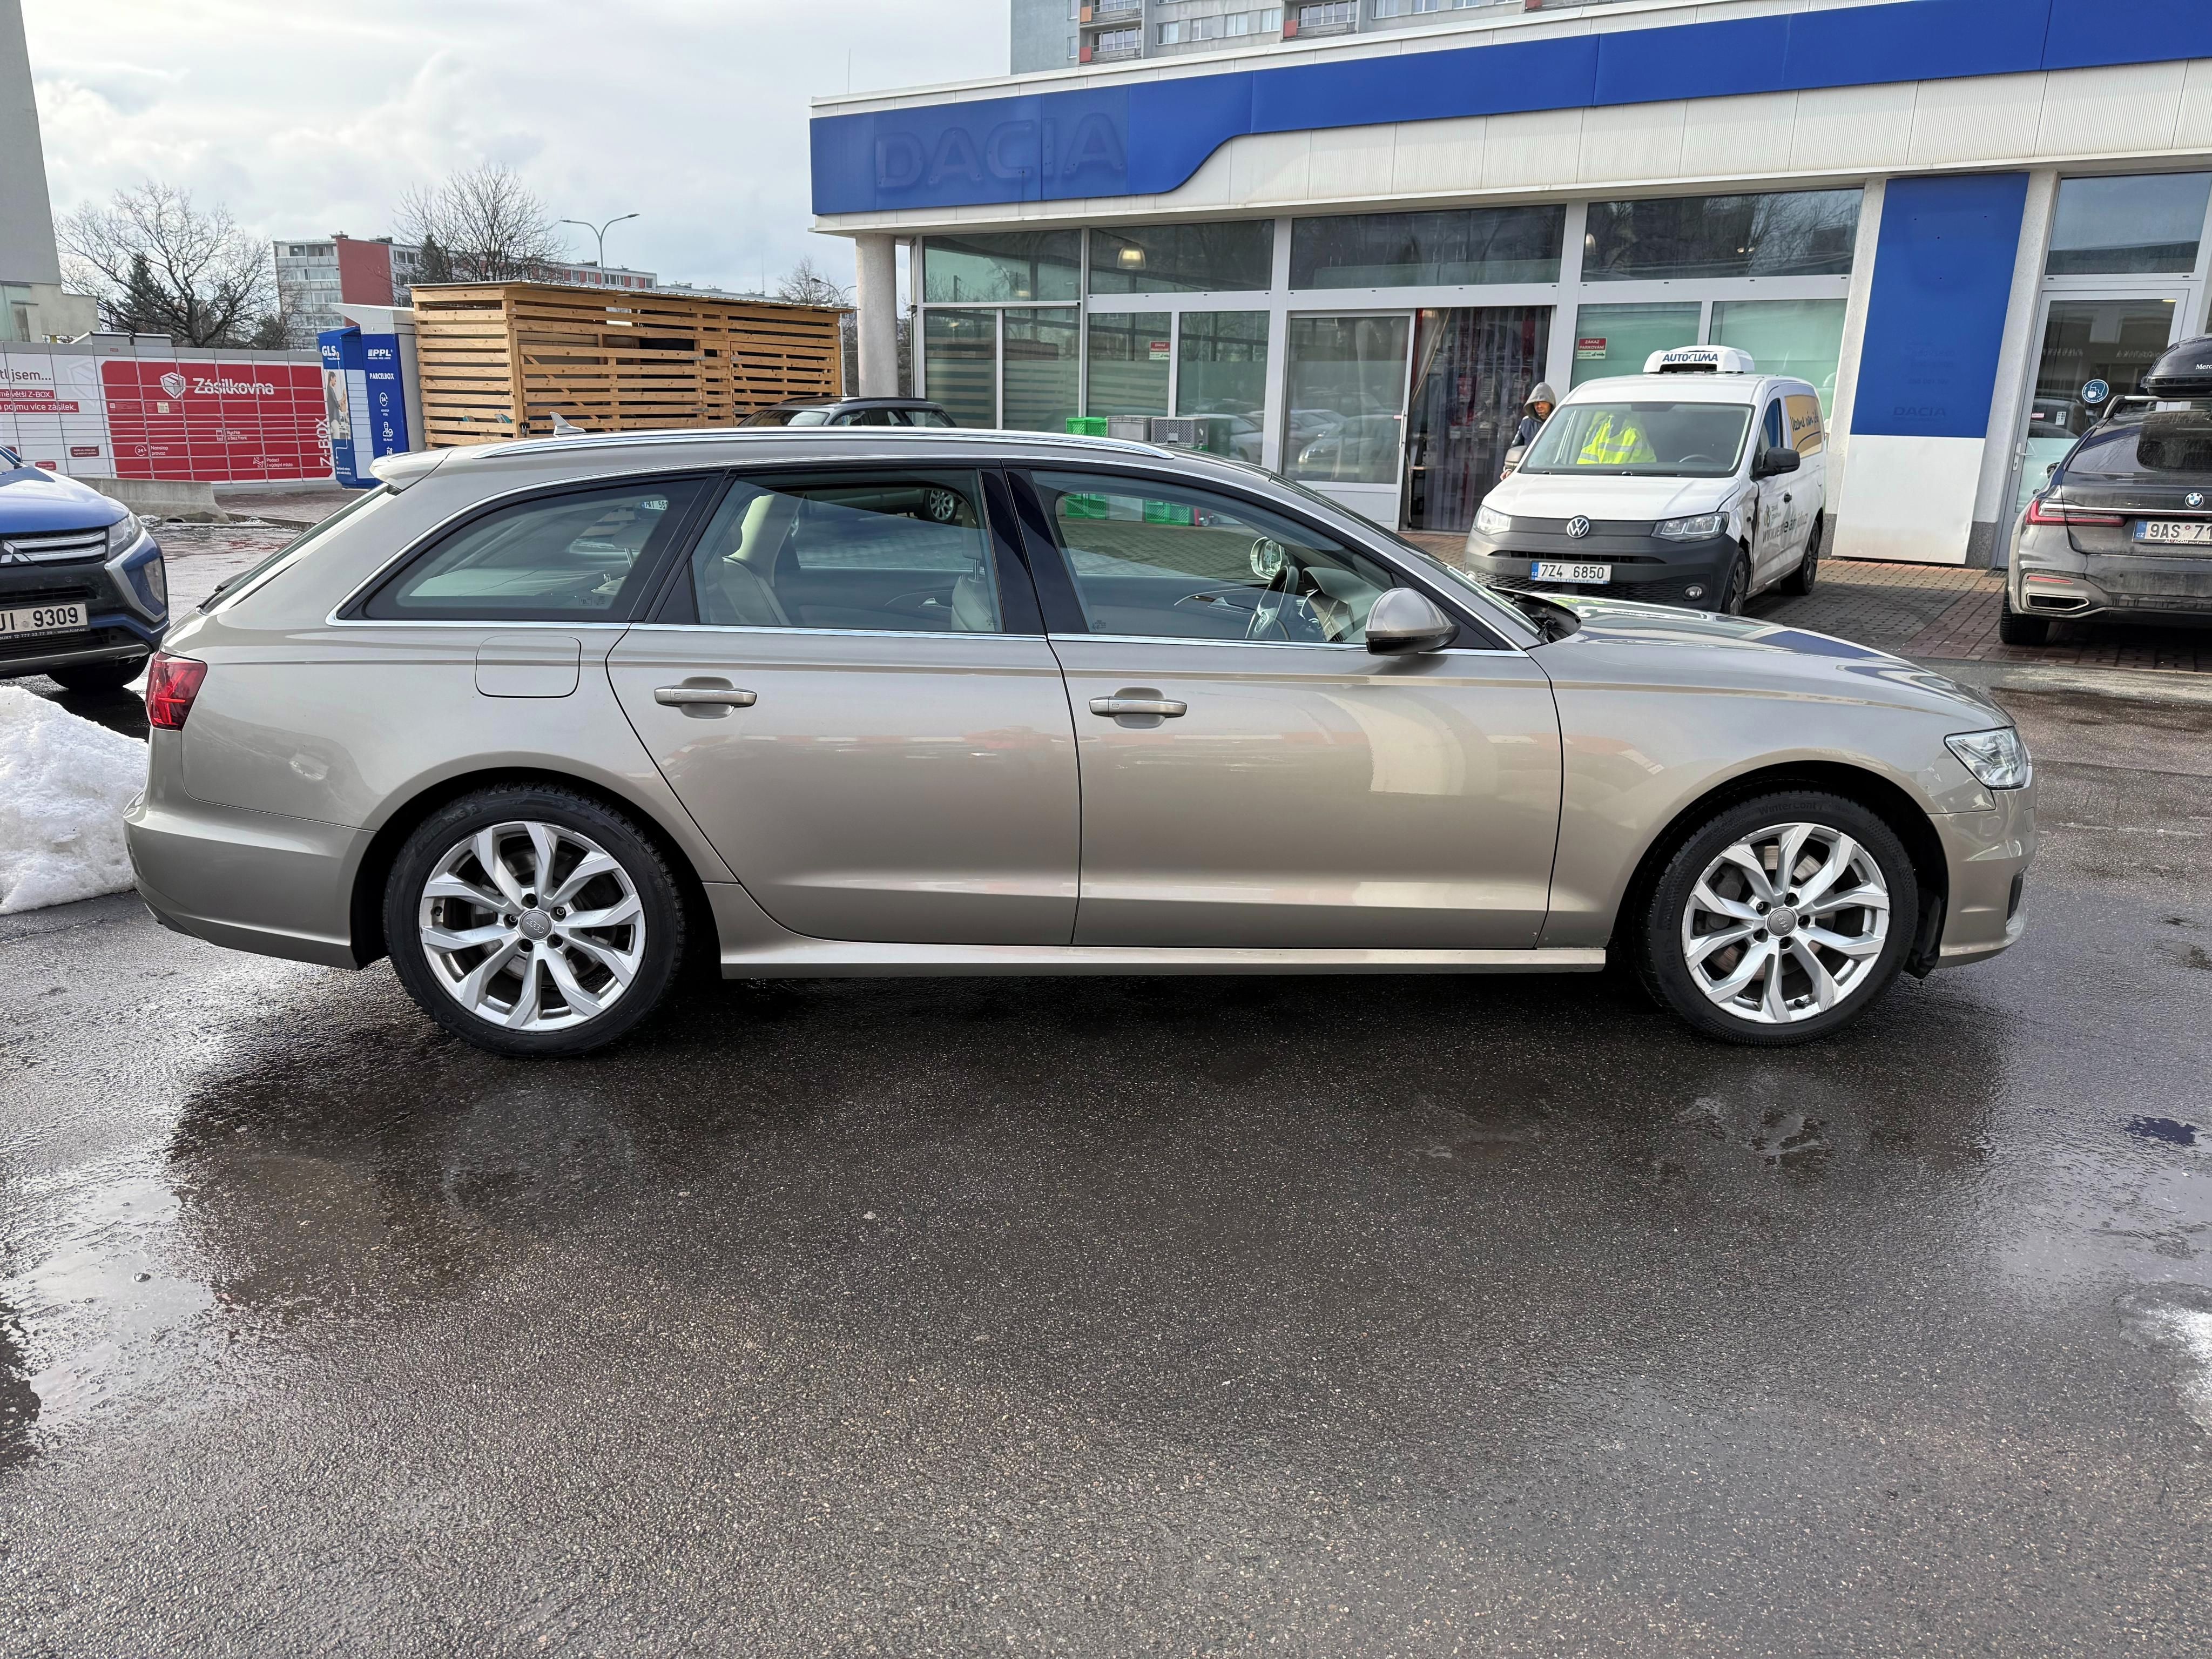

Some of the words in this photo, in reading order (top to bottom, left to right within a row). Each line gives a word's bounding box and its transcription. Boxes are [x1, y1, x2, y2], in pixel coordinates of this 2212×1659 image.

[874, 112, 1127, 189] DACIA
[321, 345, 336, 356] GLS
[1662, 353, 1718, 362] AUTOCLIMA
[11, 369, 51, 382] jsem...
[192, 377, 274, 395] Zásilkovna
[4, 403, 29, 412] pojmu
[1893, 407, 1946, 416] DACIA
[315, 417, 332, 467] Z-BOX
[2150, 524, 2181, 538] 9AS
[1541, 564, 1563, 577] 7Z4
[1573, 566, 1604, 579] 6850
[32, 607, 78, 628] 9309
